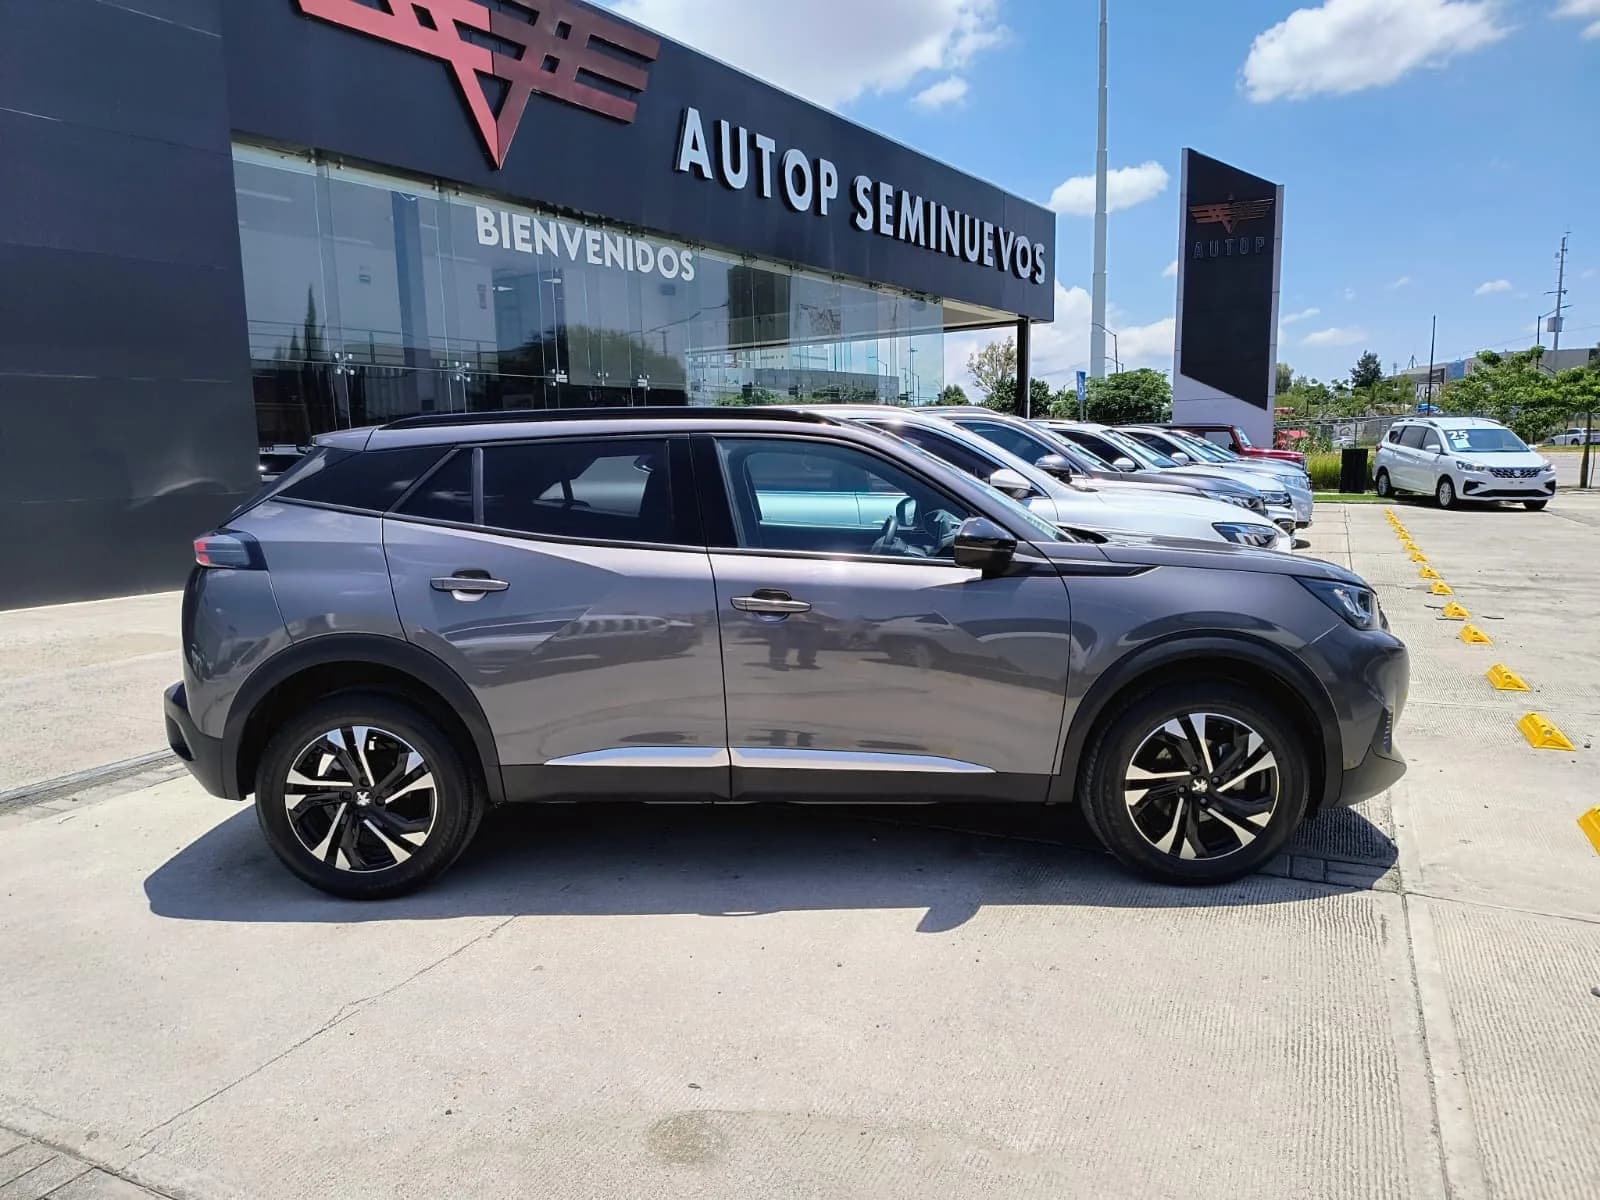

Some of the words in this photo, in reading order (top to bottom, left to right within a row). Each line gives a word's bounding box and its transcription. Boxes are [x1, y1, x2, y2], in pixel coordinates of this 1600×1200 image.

[676, 107, 838, 216] AUTOP
[853, 175, 1046, 284] SEMINUEVOS
[477, 207, 695, 281] BIENVENIDOS
[1194, 237, 1265, 258] AUTOP
[1448, 430, 1469, 440] 25
